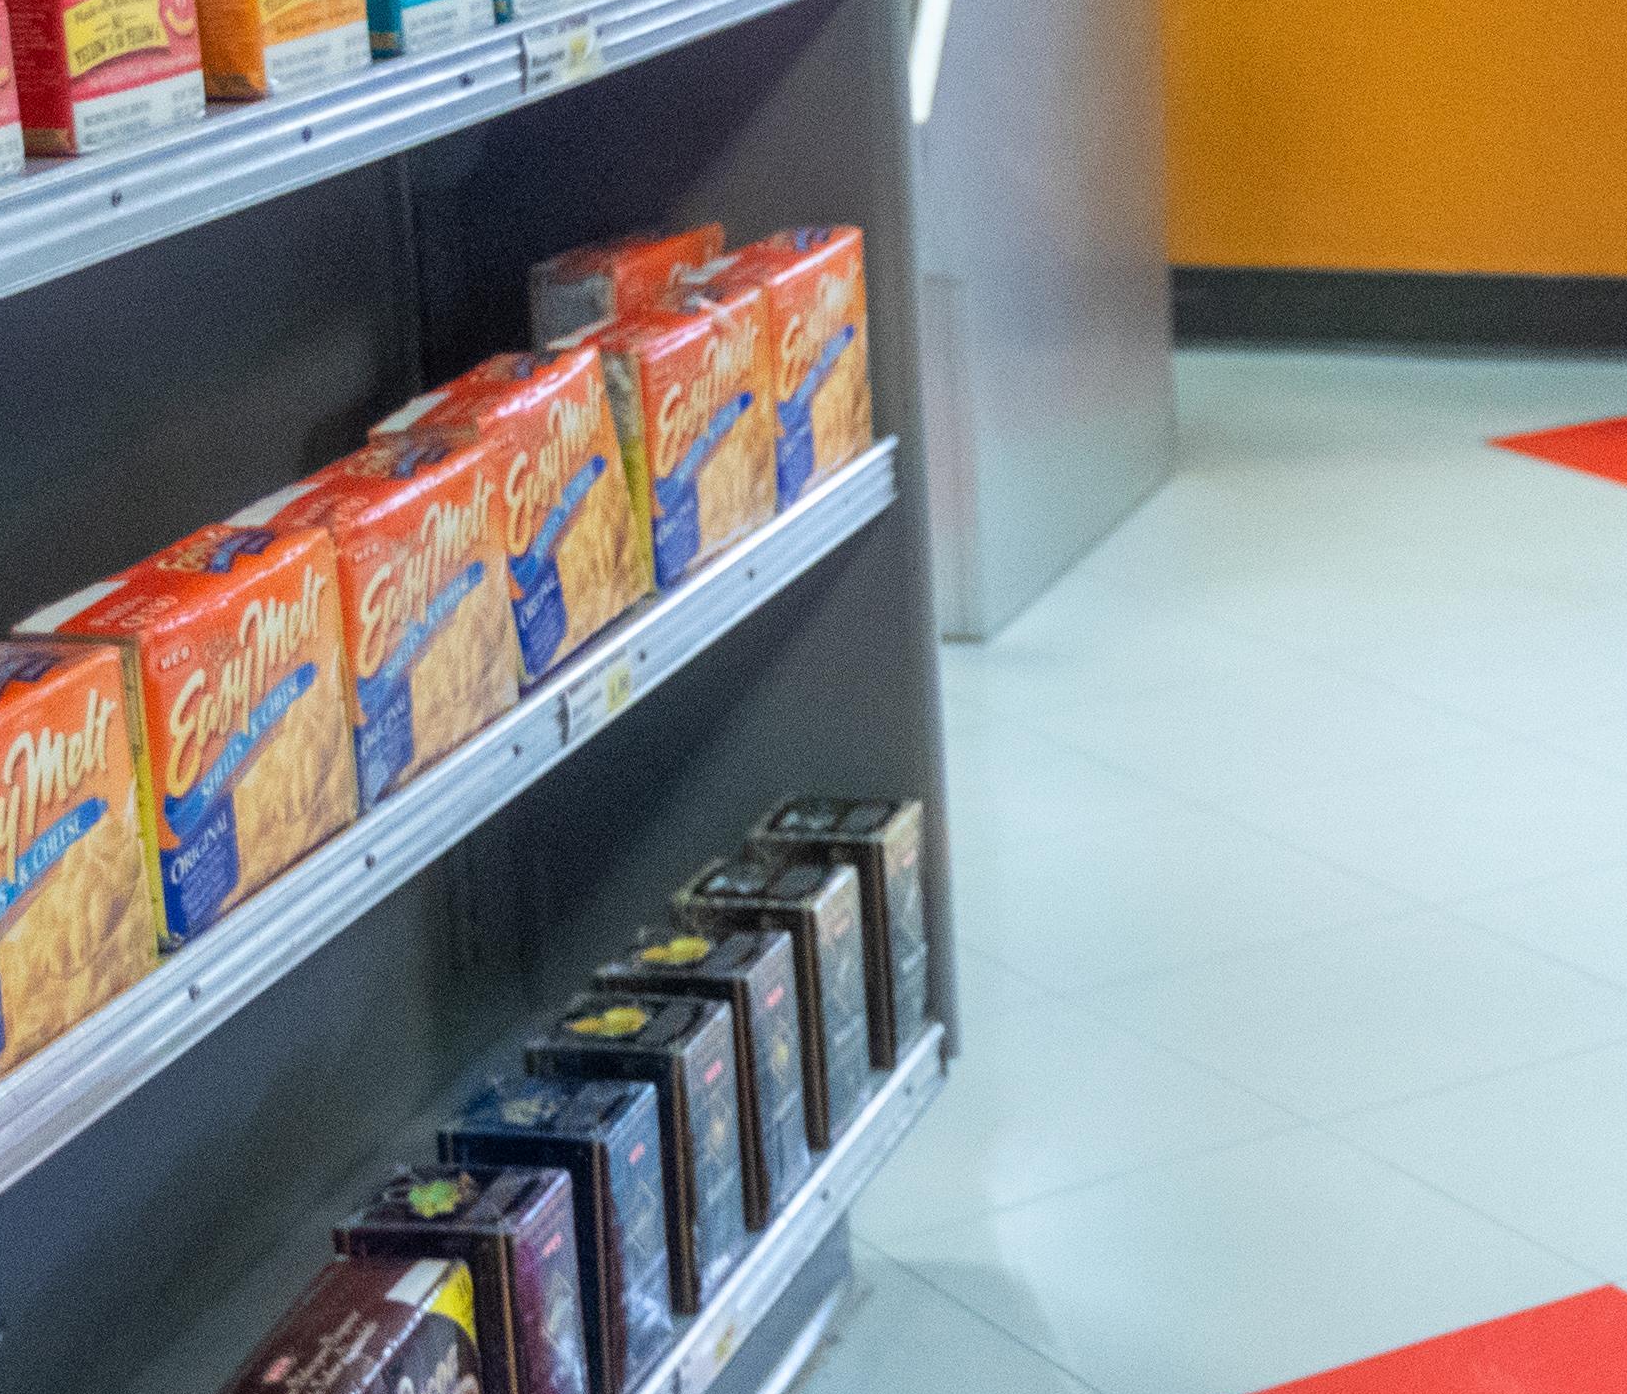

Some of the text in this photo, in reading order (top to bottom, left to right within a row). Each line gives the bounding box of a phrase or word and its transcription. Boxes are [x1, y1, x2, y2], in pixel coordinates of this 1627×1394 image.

[4, 689, 118, 840] Melt
[166, 563, 327, 797] Easy Melt
